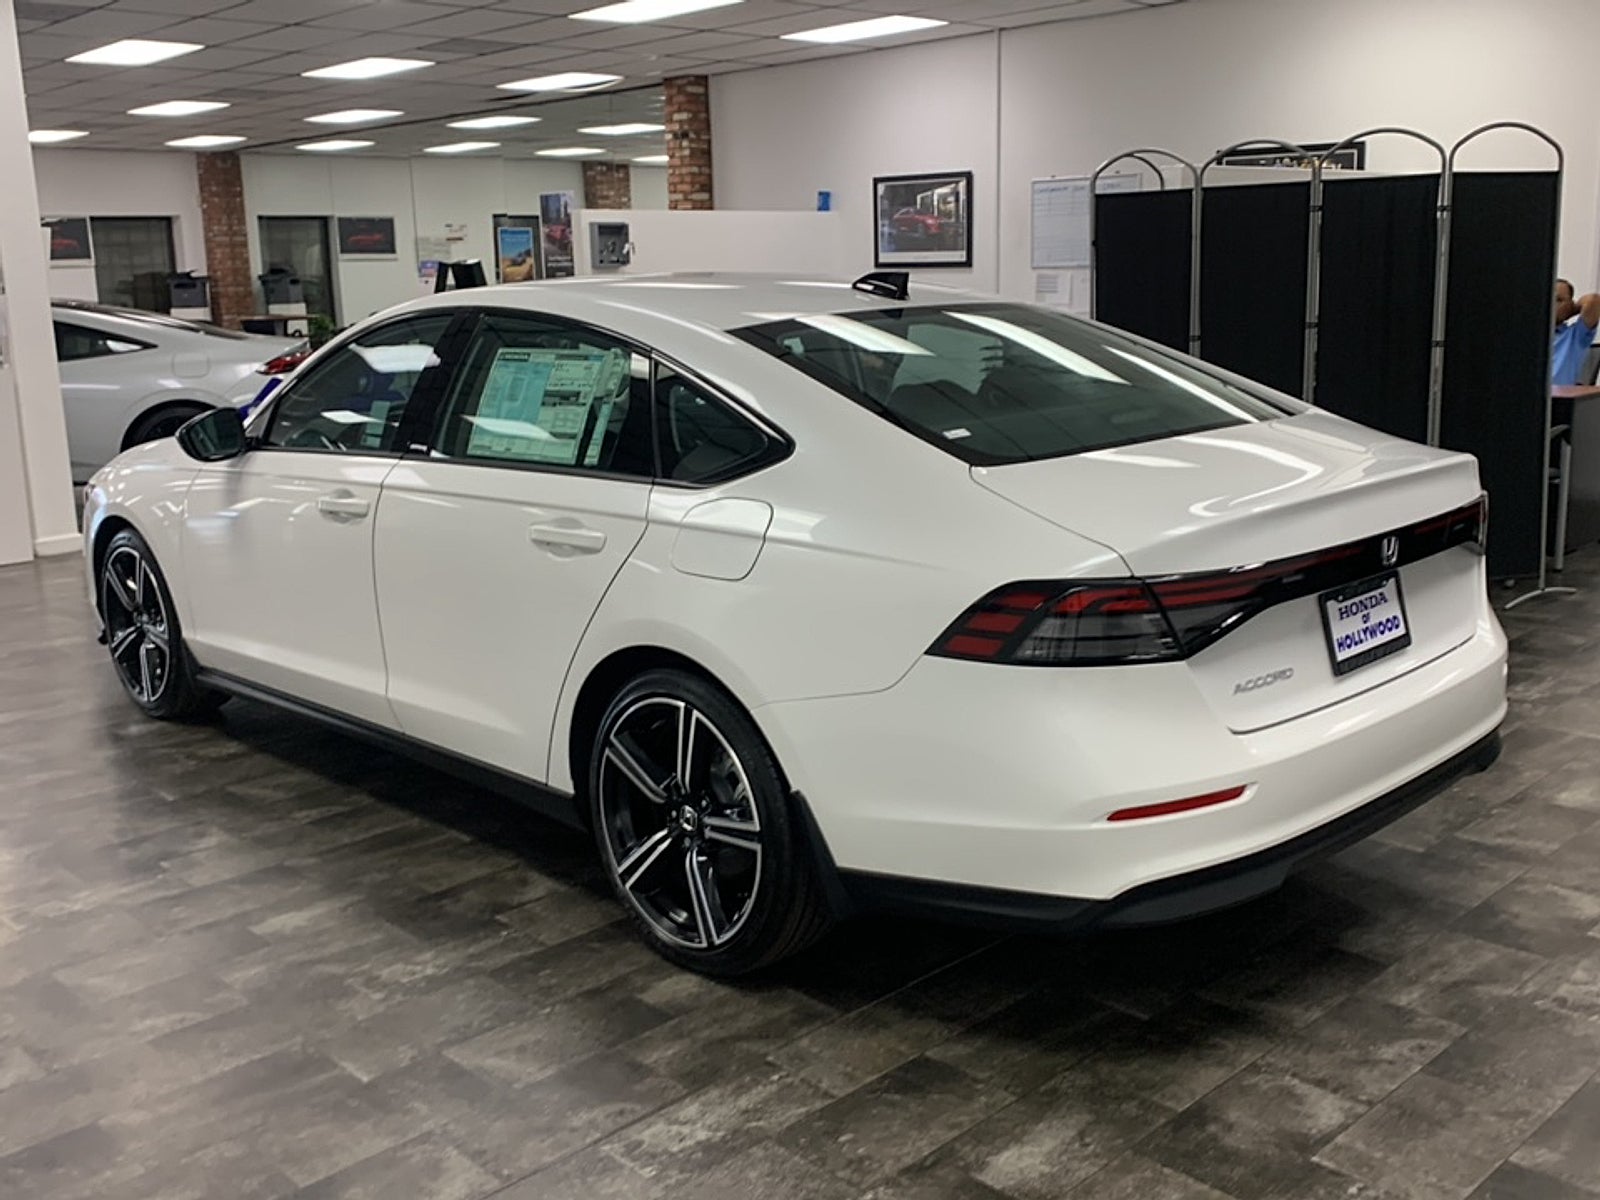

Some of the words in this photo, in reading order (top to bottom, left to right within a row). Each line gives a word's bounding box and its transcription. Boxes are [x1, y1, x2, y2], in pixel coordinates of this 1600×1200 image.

[1338, 592, 1388, 620] HONDA
[1361, 612, 1370, 624] OF
[1337, 615, 1400, 652] HOLLYWOOD
[1232, 667, 1294, 696] ACCORD
